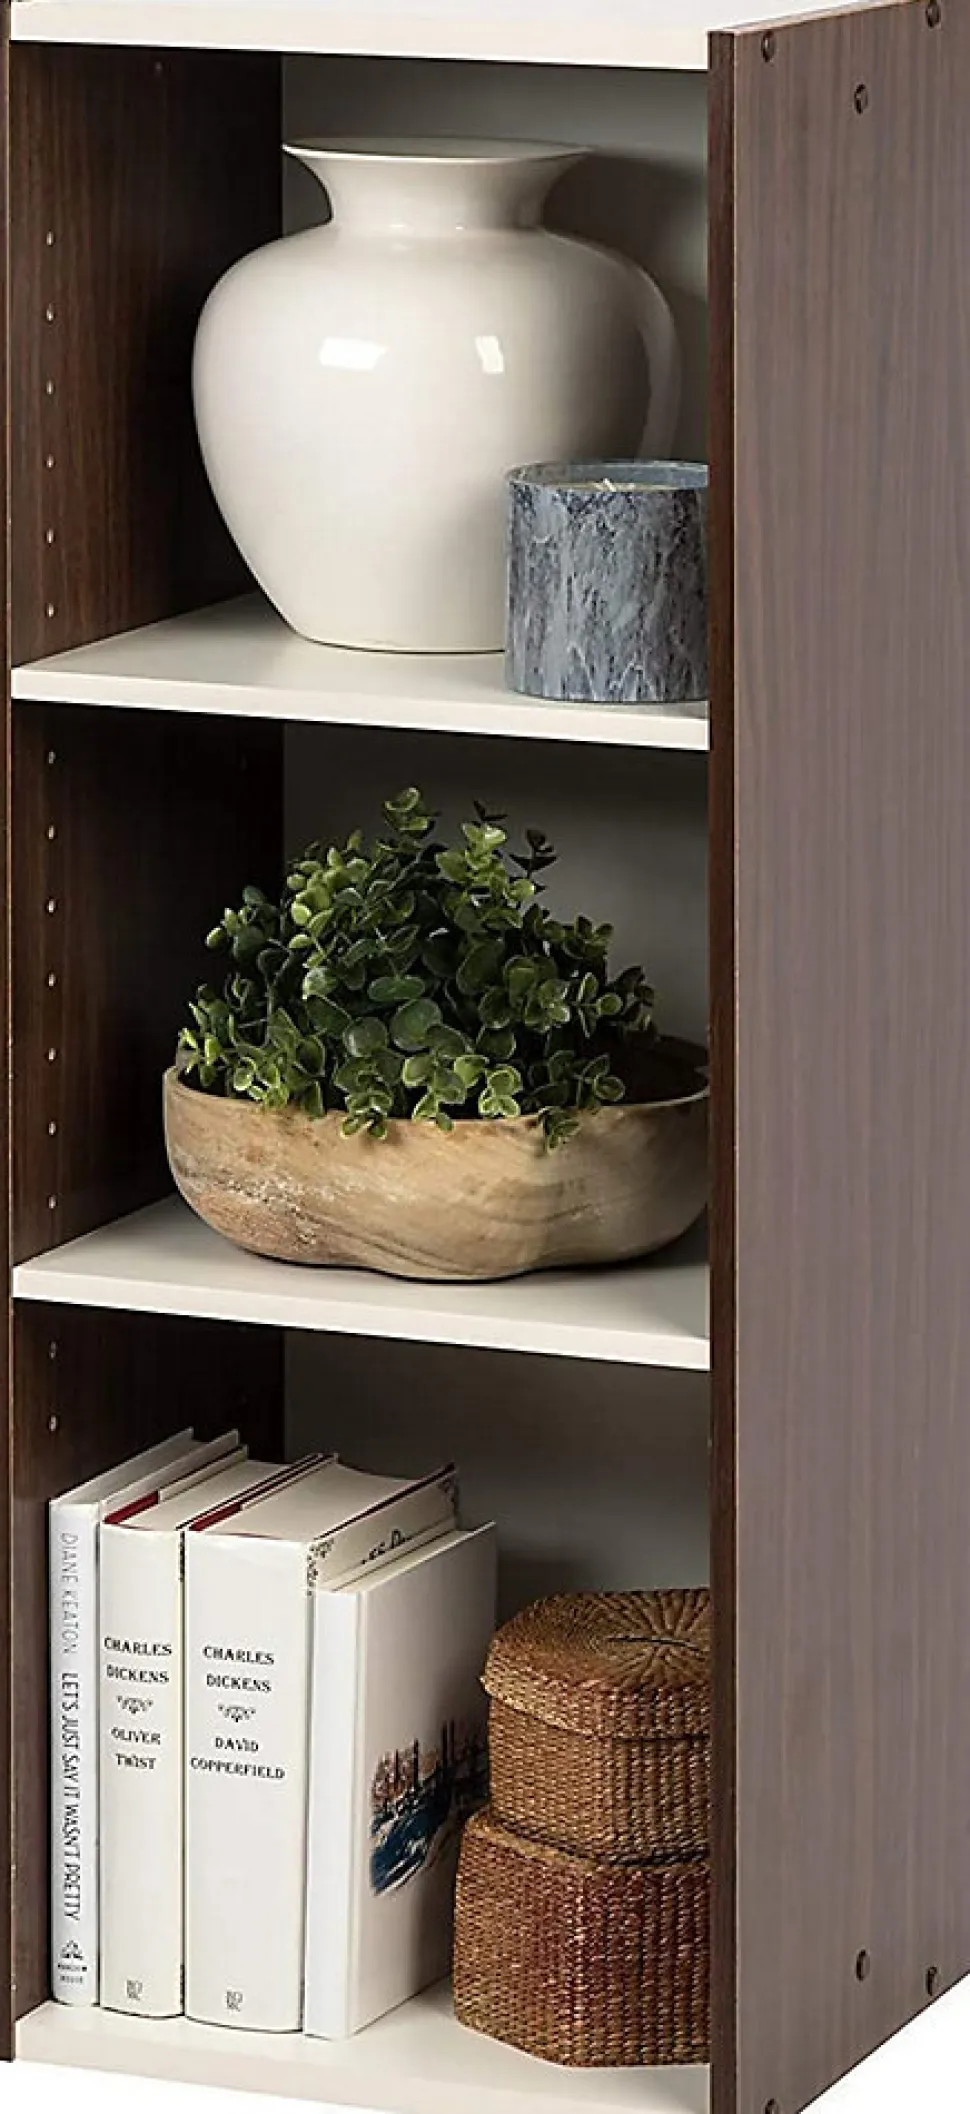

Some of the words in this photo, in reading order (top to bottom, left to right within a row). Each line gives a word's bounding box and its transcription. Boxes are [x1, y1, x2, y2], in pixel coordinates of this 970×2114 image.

[61, 1532, 79, 1583] DIANE
[61, 1590, 79, 1654] KEATON
[104, 1636, 172, 1656] CHARLES
[202, 1646, 274, 1665] CHARLES
[106, 1664, 169, 1684] DICKENS
[206, 1673, 272, 1692] DICKENS
[61, 1715, 80, 1749] JUST
[111, 1727, 161, 1745] OLIVER
[215, 1736, 259, 1752] DAVID
[61, 1753, 80, 1782] SAY
[115, 1753, 156, 1769] TWIST
[190, 1757, 285, 1779] COPPERFIELD
[63, 1786, 80, 1799] IT
[63, 1864, 80, 1921] PRETTY
